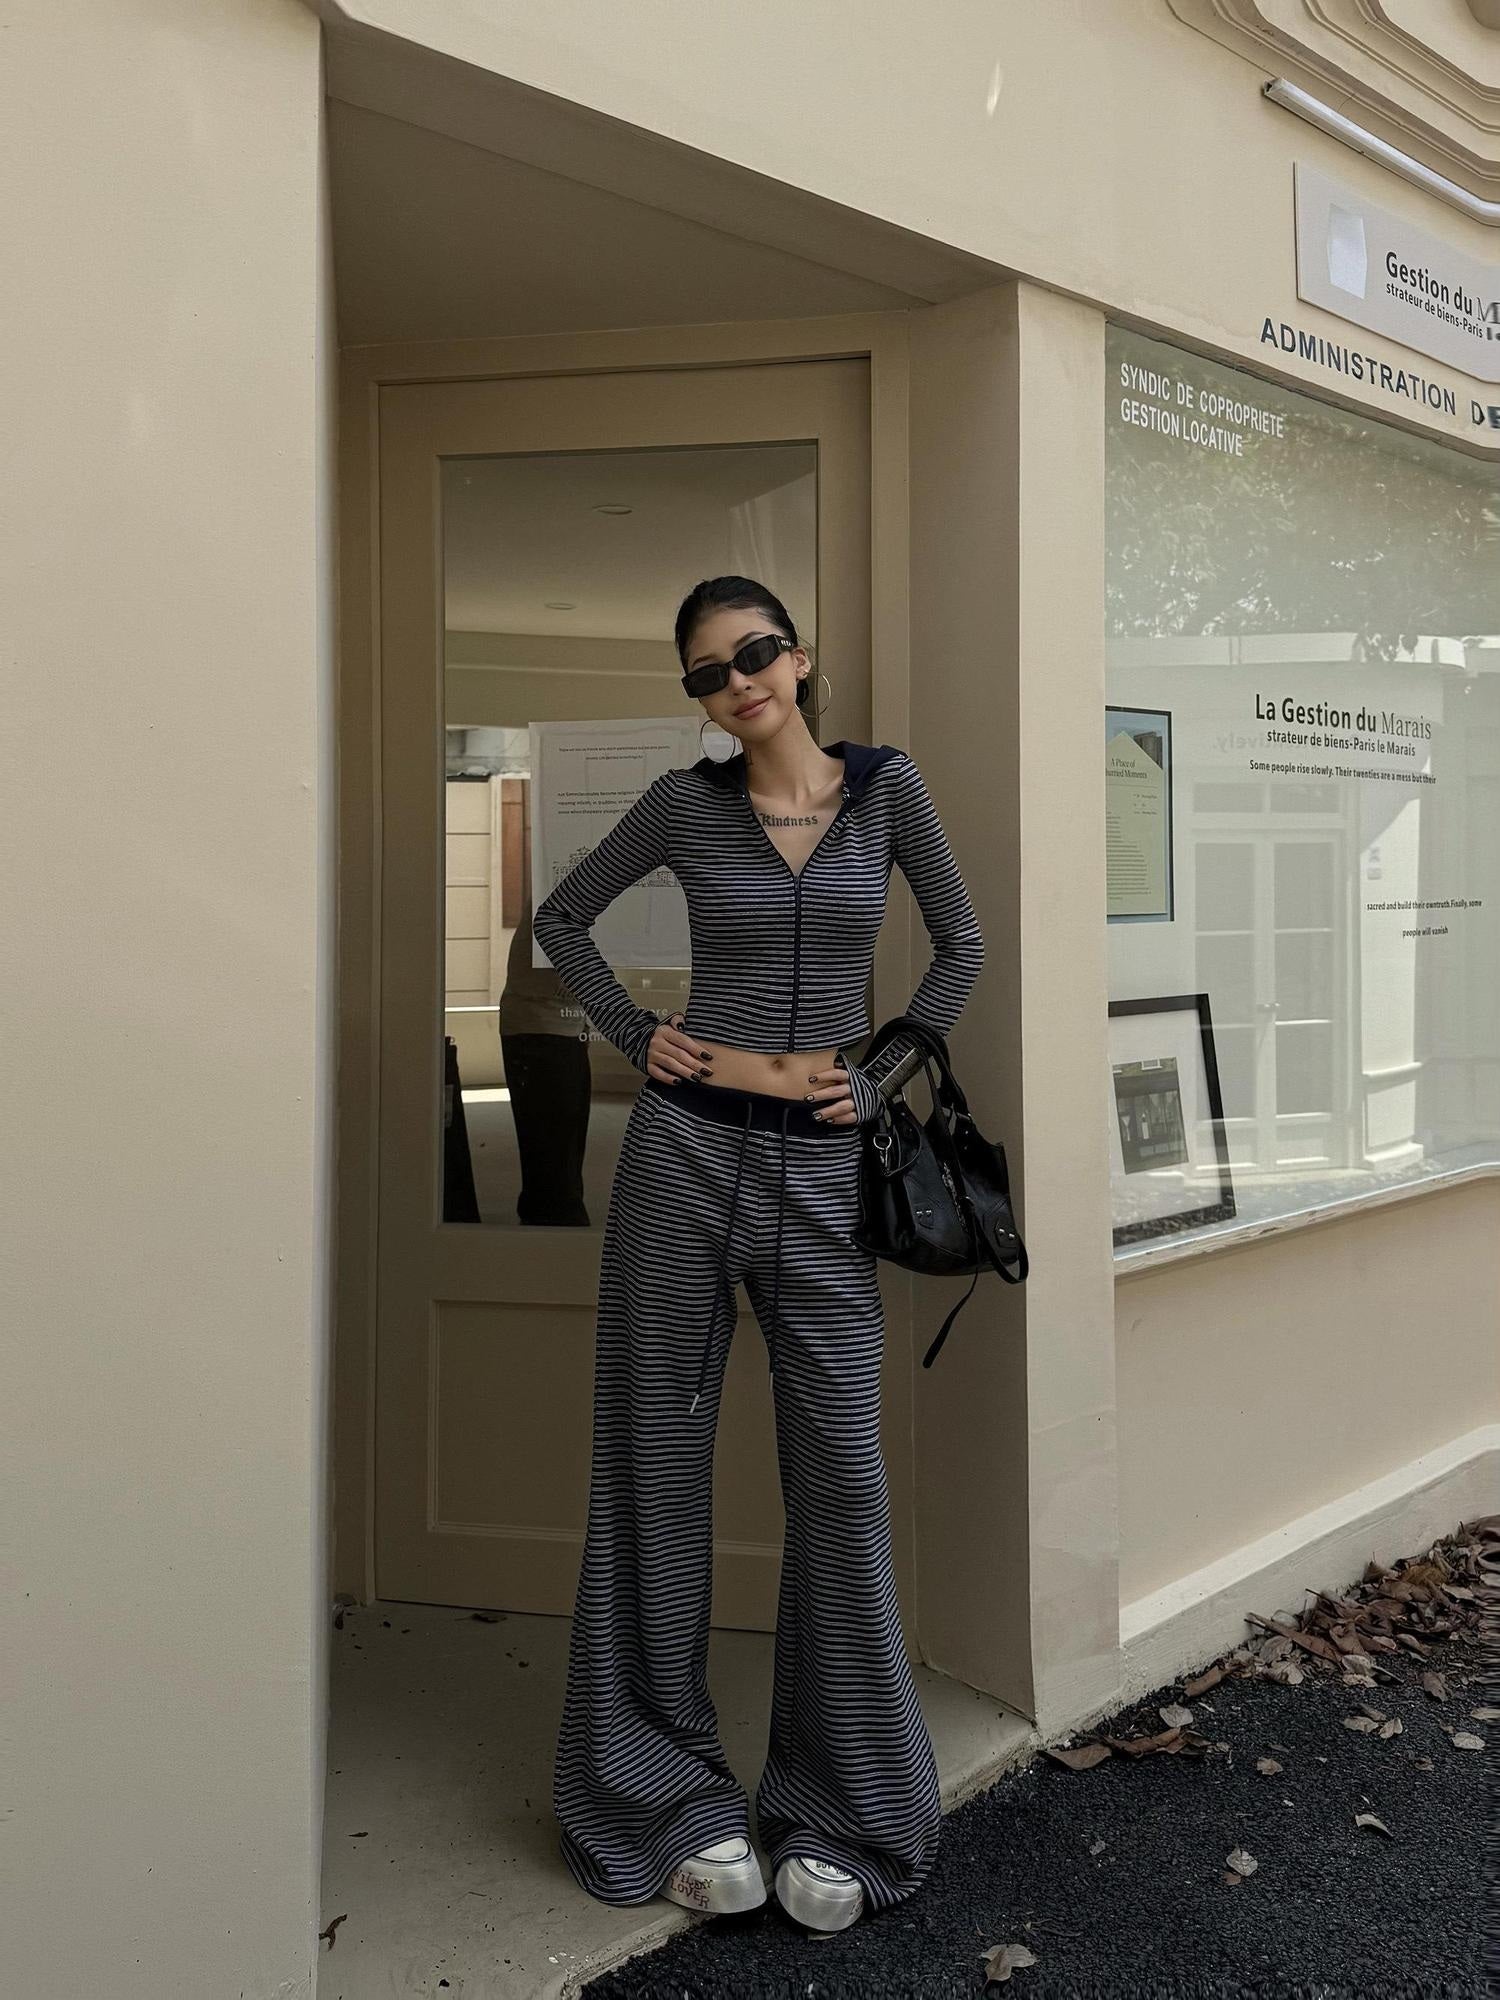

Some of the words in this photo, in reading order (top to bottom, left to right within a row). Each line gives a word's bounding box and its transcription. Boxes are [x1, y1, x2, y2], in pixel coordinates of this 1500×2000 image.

[1386, 251, 1449, 304] Gestion
[1454, 286, 1473, 316] du
[1386, 283, 1423, 309] strateur
[1425, 299, 1436, 315] de
[1437, 304, 1483, 338] biens-Paris
[1260, 317, 1456, 416] ADMINISTRATION
[1121, 362, 1171, 401] SYNDIC
[1177, 382, 1194, 409] DE
[1200, 390, 1285, 439] COPROPRIETE
[1121, 398, 1180, 438] GESTION
[1183, 416, 1243, 457] LOCATIVE
[1256, 694, 1276, 721] La
[1282, 697, 1351, 730] Gestion
[1356, 707, 1377, 733] du
[1382, 711, 1432, 740] Marais
[1267, 730, 1308, 745] strateur
[1310, 732, 1322, 747] de
[1324, 734, 1375, 753] biens-Paris
[1377, 740, 1385, 753] le
[1387, 741, 1416, 757] Marais
[1249, 760, 1270, 771] Some
[1271, 762, 1296, 775] people
[1297, 763, 1310, 774] rise
[1311, 765, 1334, 778] slowly.
[759, 813, 818, 827] Kindness
[1367, 902, 1386, 911] sacred
[1386, 902, 1397, 910] and
[670, 1878, 710, 1909] LOVER
